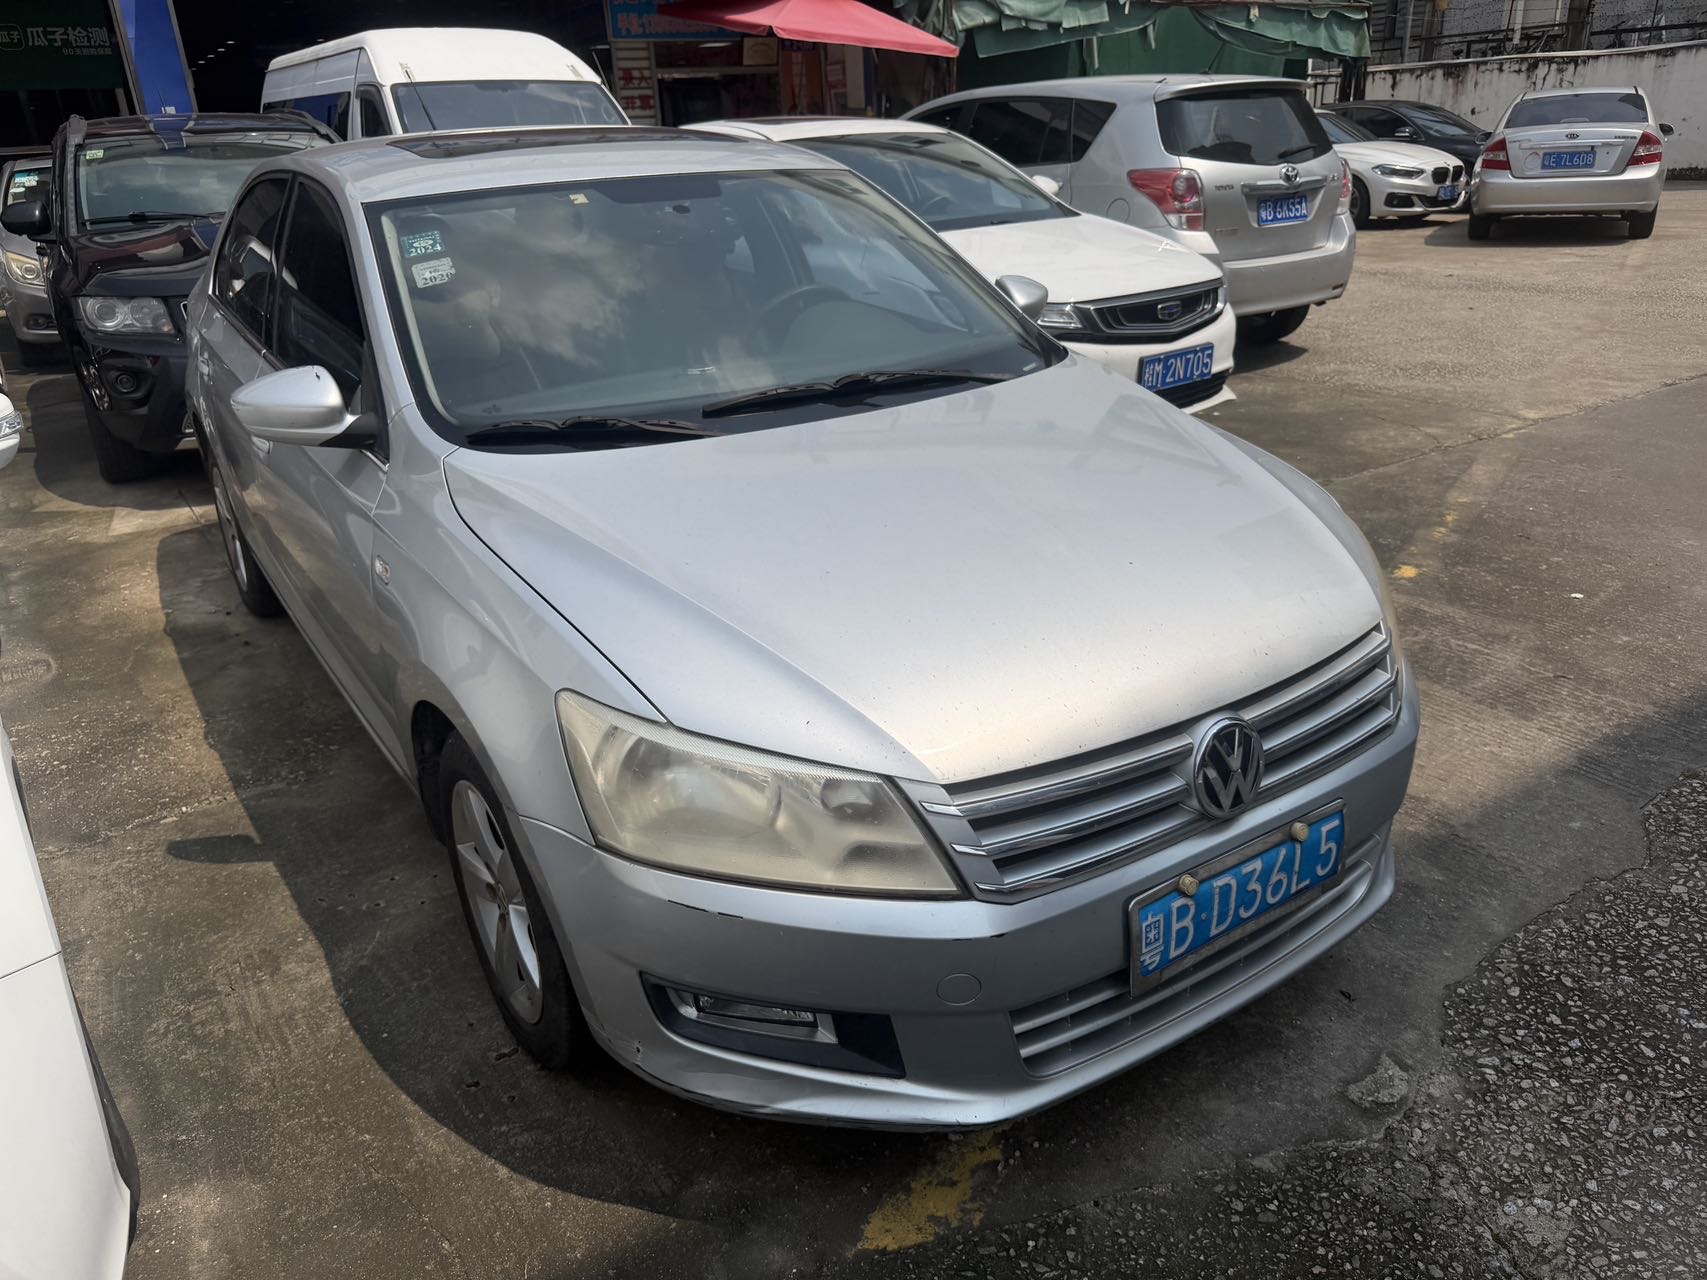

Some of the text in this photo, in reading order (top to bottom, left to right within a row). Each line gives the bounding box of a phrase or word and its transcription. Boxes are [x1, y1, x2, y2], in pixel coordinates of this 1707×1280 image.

[26, 26, 110, 47] 瓜子检测
[409, 243, 442, 257] 2024
